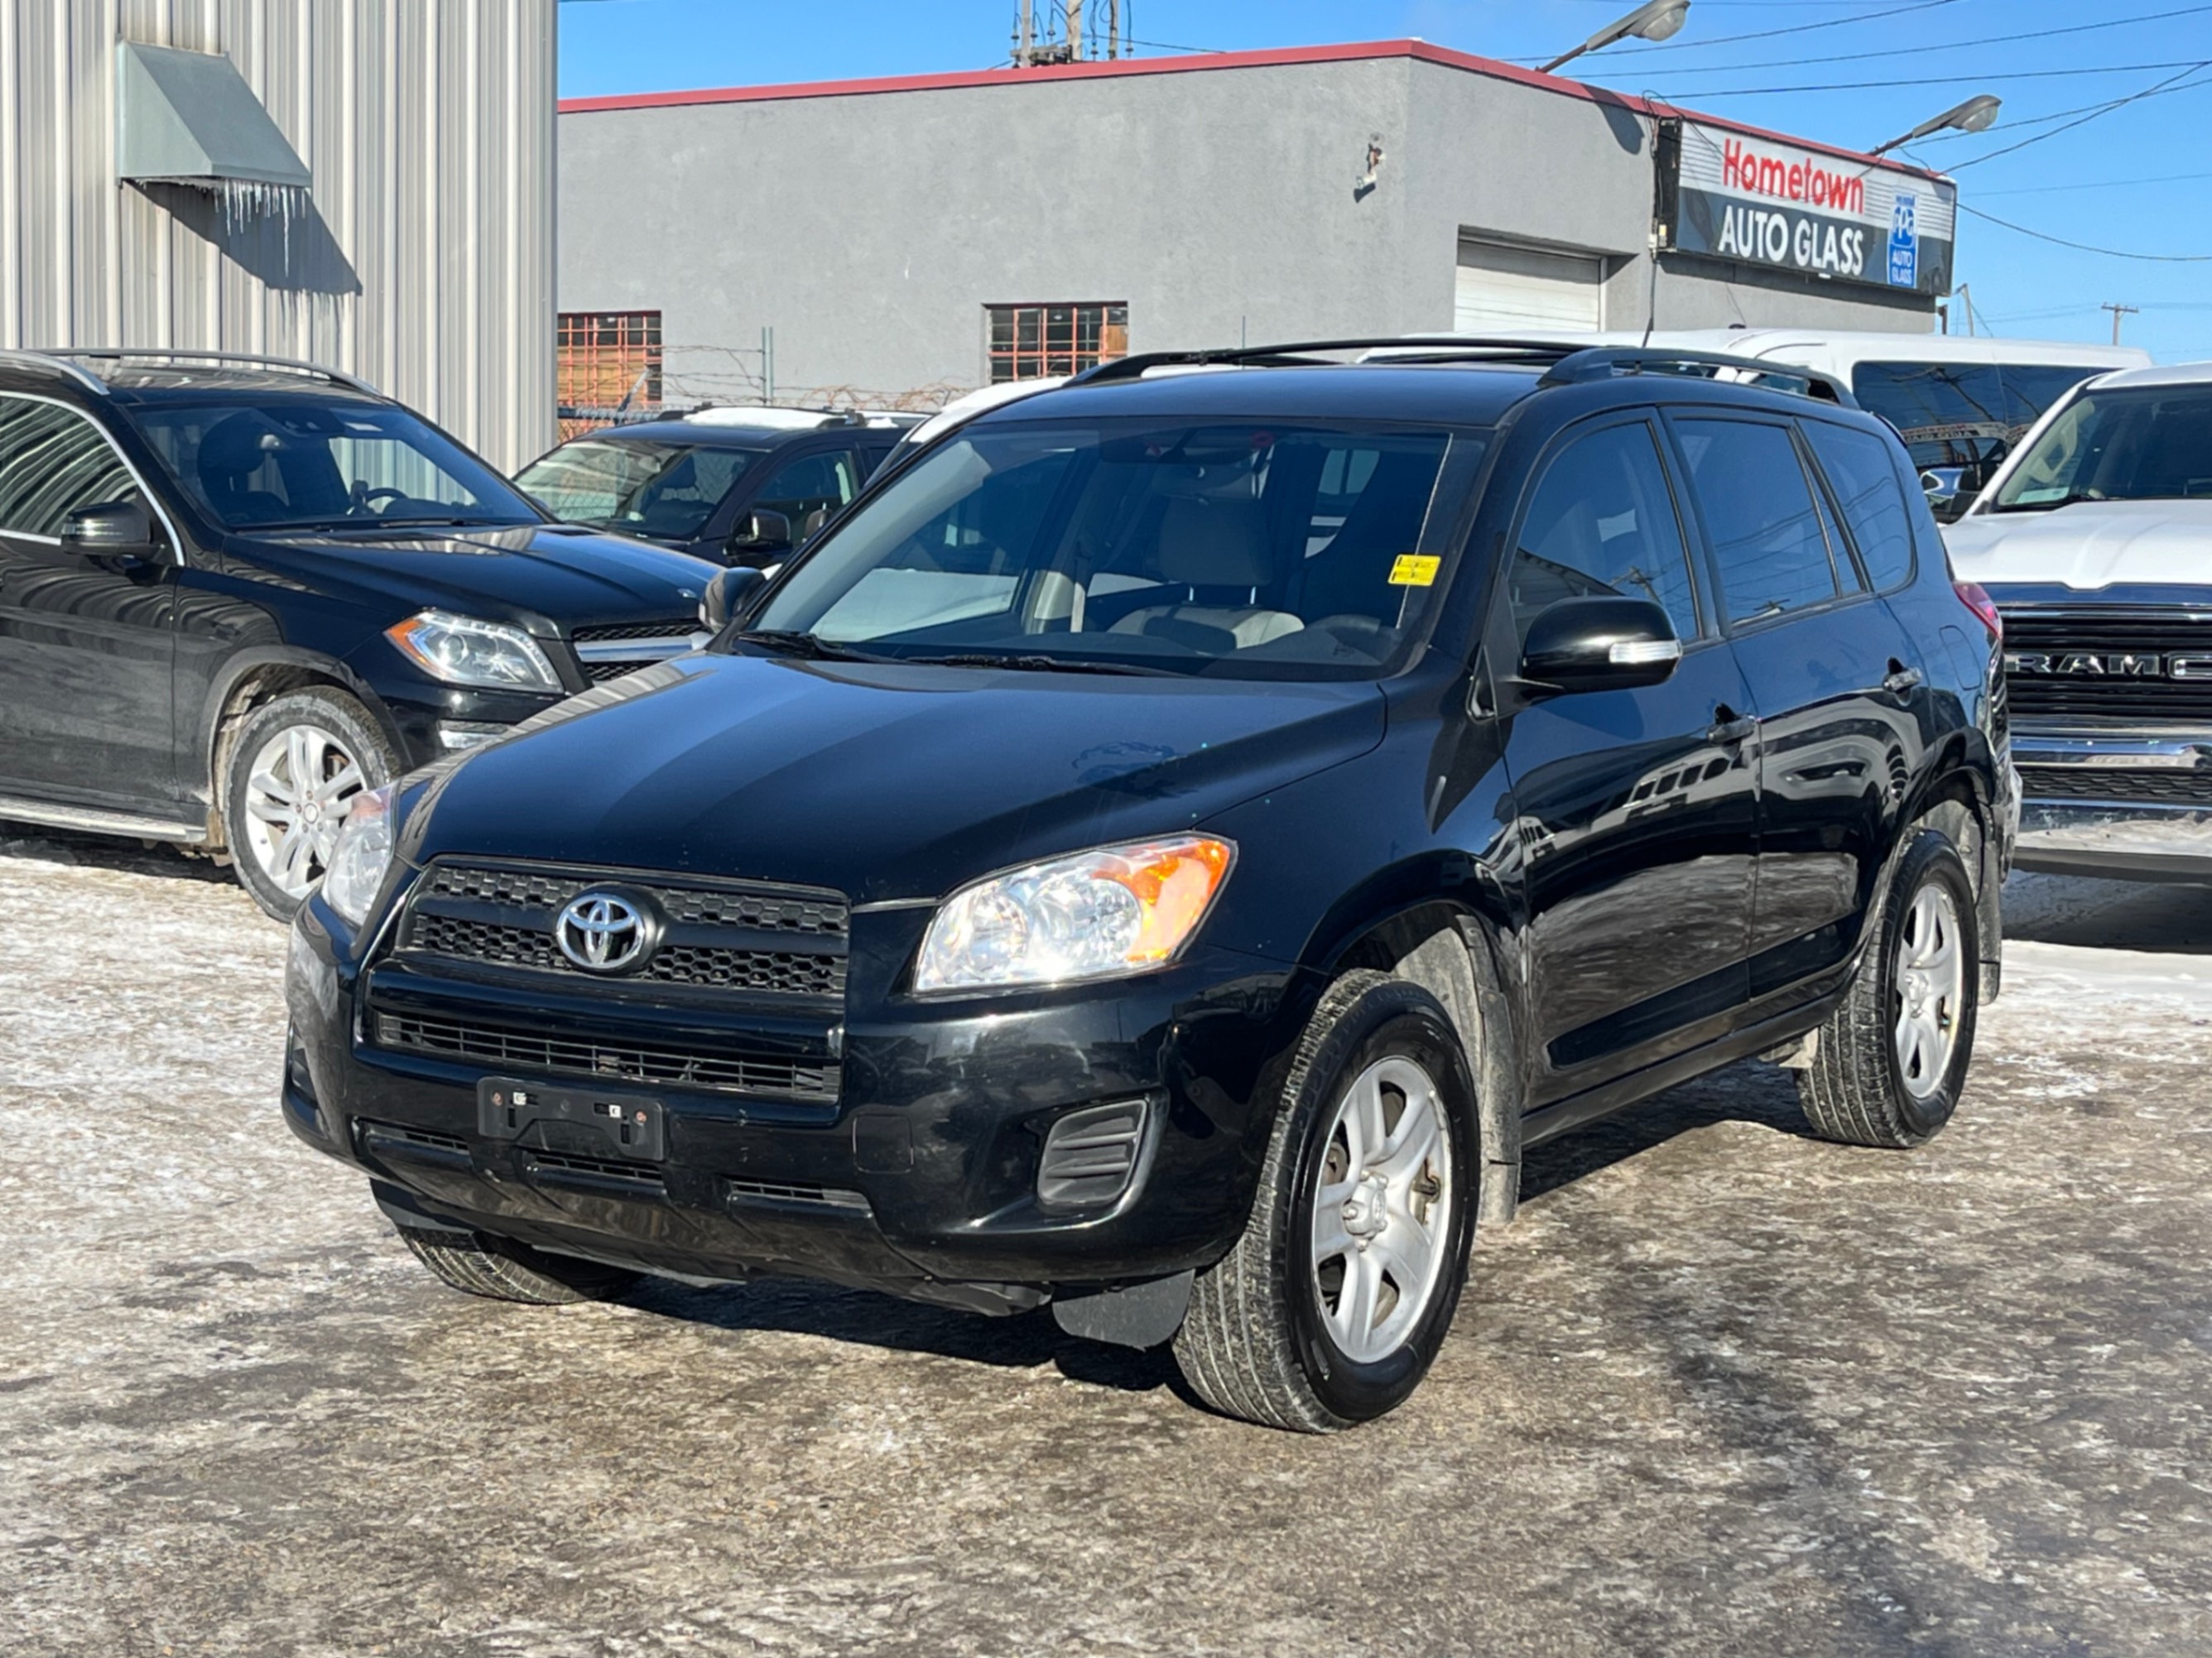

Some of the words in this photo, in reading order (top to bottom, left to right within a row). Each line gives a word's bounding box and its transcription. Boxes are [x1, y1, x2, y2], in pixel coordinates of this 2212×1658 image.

[1723, 137, 1864, 214] Hometown
[1718, 204, 1789, 262] AUTO
[1793, 218, 1863, 276] GLASS
[1892, 249, 1913, 268] AUTO
[1891, 265, 1913, 286] GLASS
[2003, 654, 2160, 674] RAM
